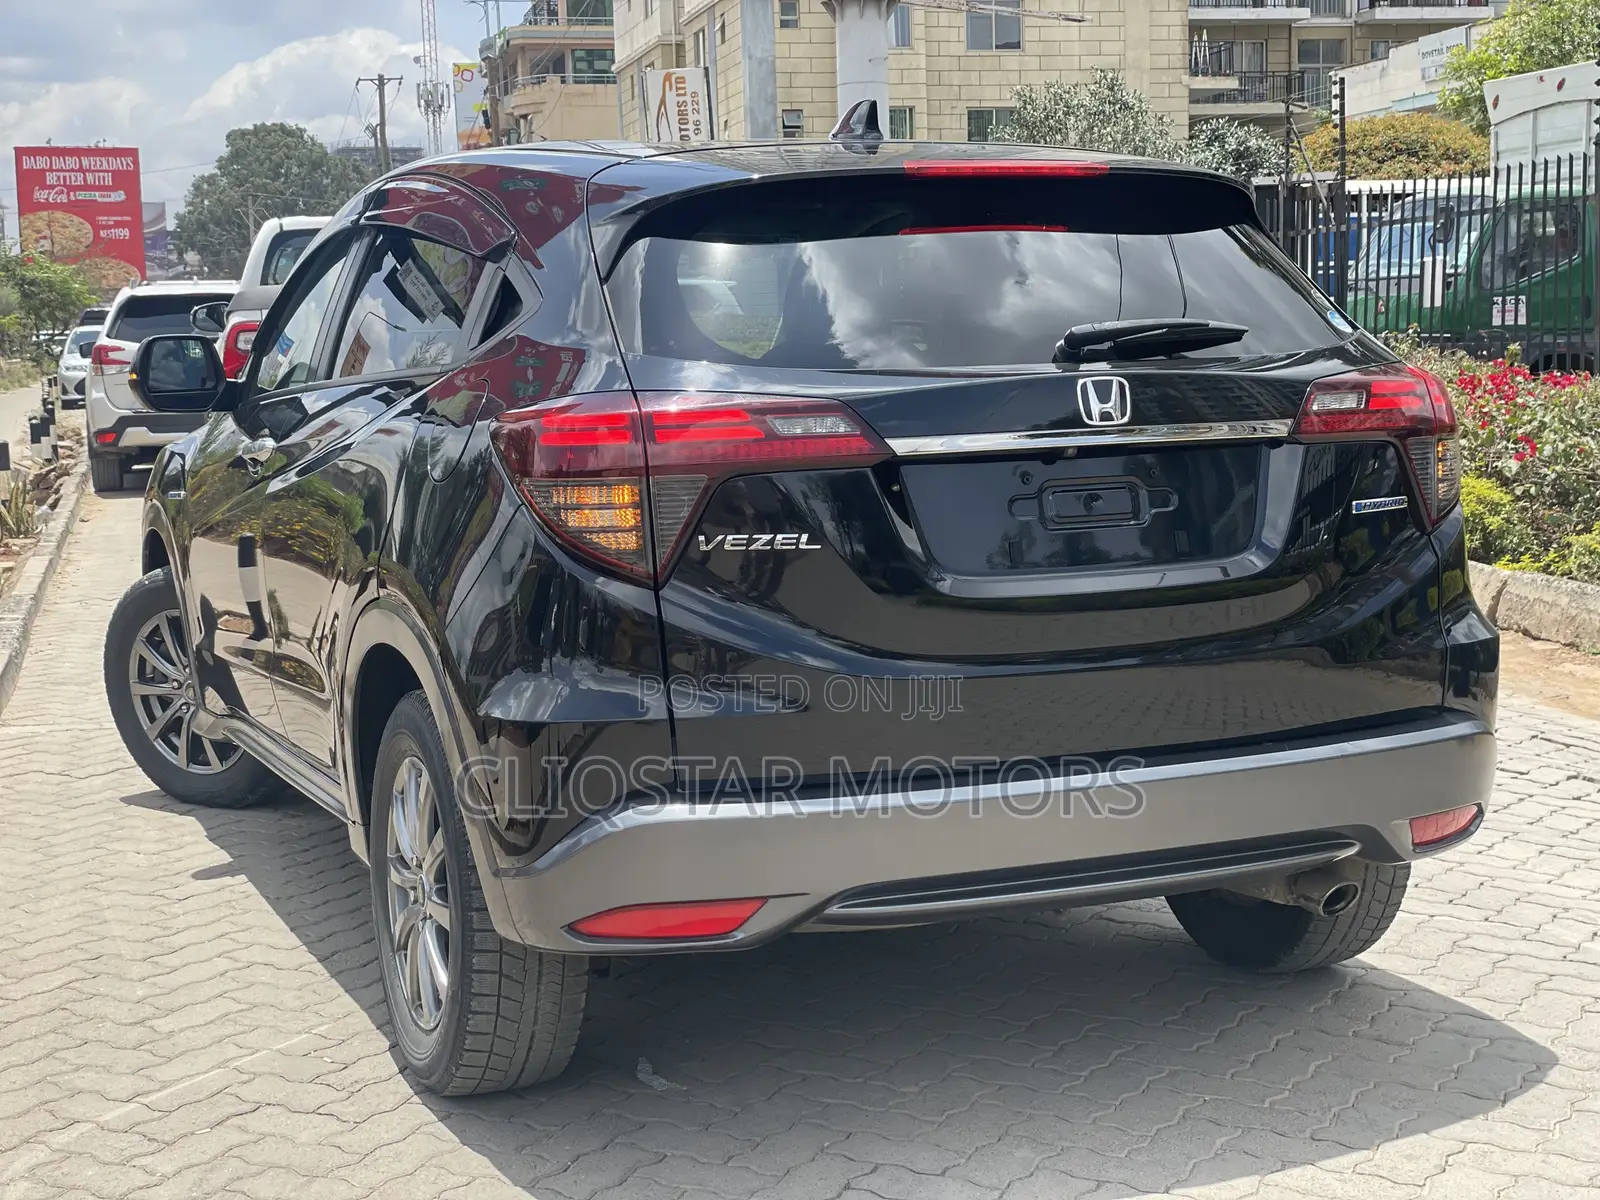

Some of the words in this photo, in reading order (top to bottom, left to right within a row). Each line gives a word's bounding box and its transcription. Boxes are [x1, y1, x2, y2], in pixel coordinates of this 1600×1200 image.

[1421, 47, 1444, 60] DOVETAIL
[675, 76, 687, 97] LTD
[690, 91, 701, 115] 229
[693, 119, 702, 136] 96
[22, 156, 50, 170] DABO
[51, 156, 79, 170] DABO
[80, 156, 134, 171] WEEKDAYS
[46, 172, 84, 185] BETTER
[85, 172, 113, 186] WITH
[1361, 498, 1404, 511] HYBRID
[698, 533, 821, 551] VEZEL
